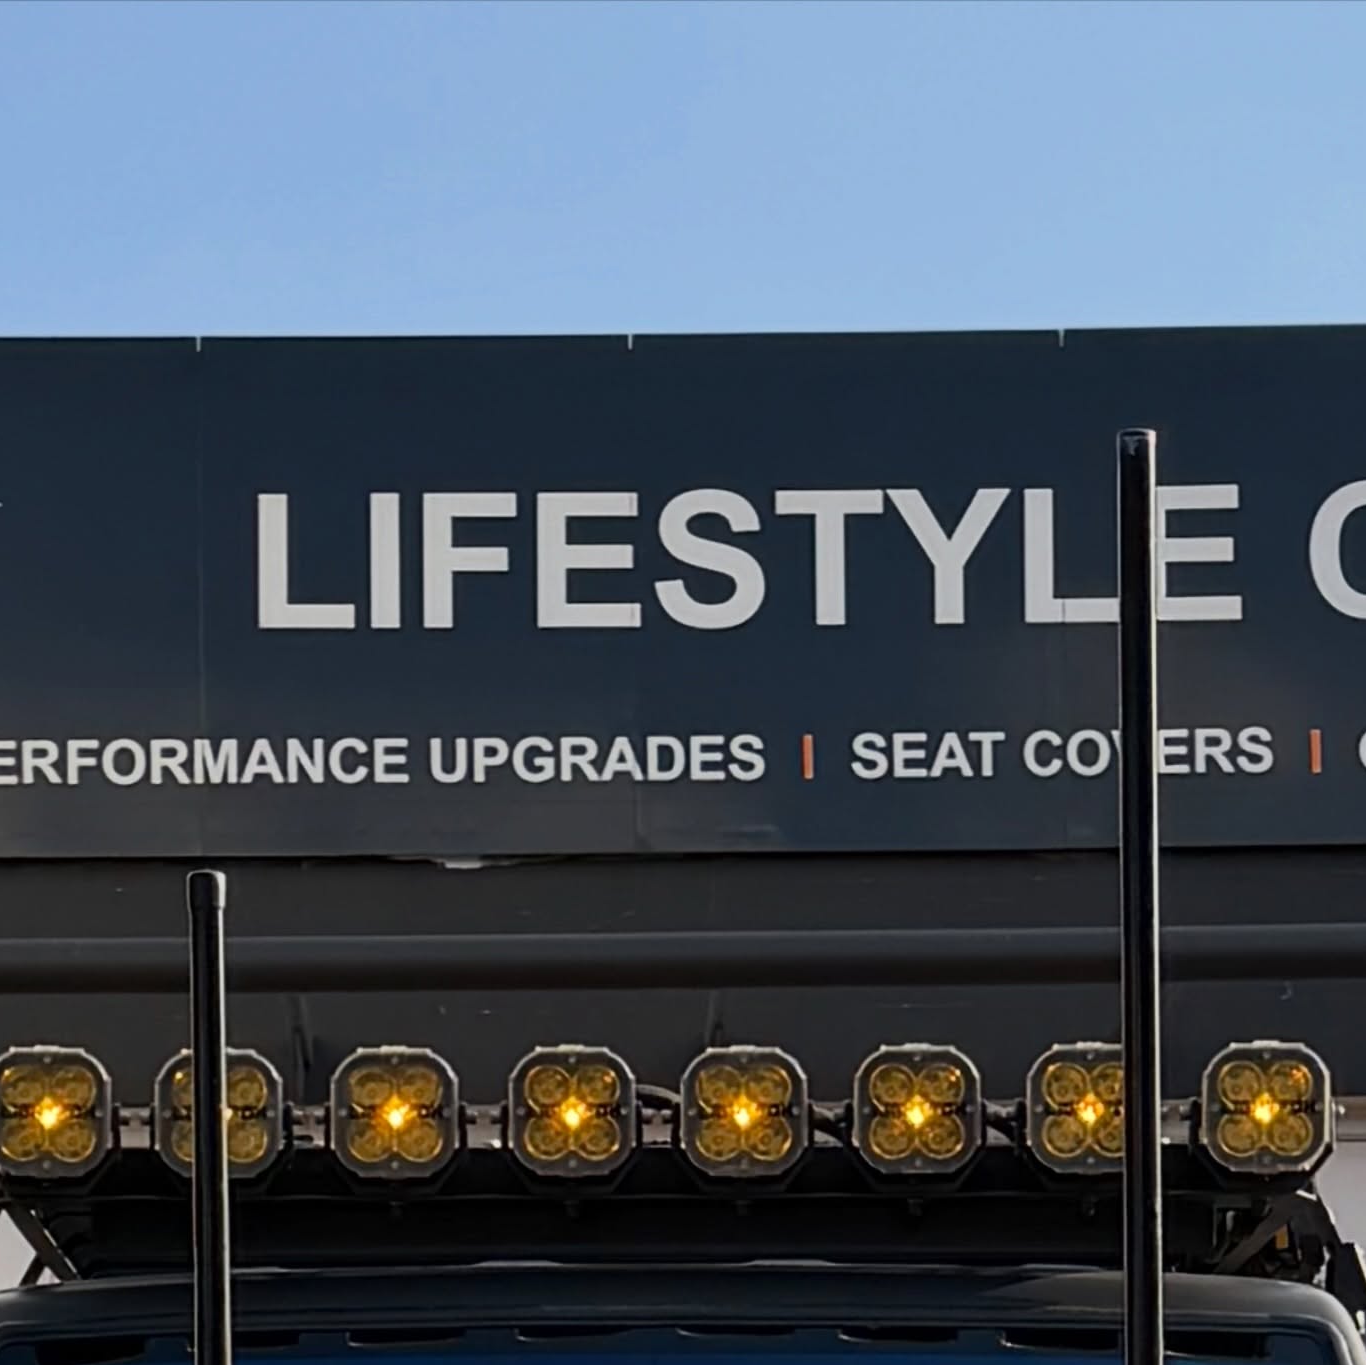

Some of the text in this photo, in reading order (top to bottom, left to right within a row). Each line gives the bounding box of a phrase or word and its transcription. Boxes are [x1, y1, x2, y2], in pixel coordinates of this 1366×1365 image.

[257, 484, 1243, 629] LIFESTYLE
[429, 733, 766, 784] UPGRADES
[850, 726, 1275, 780] SEAT COERS
